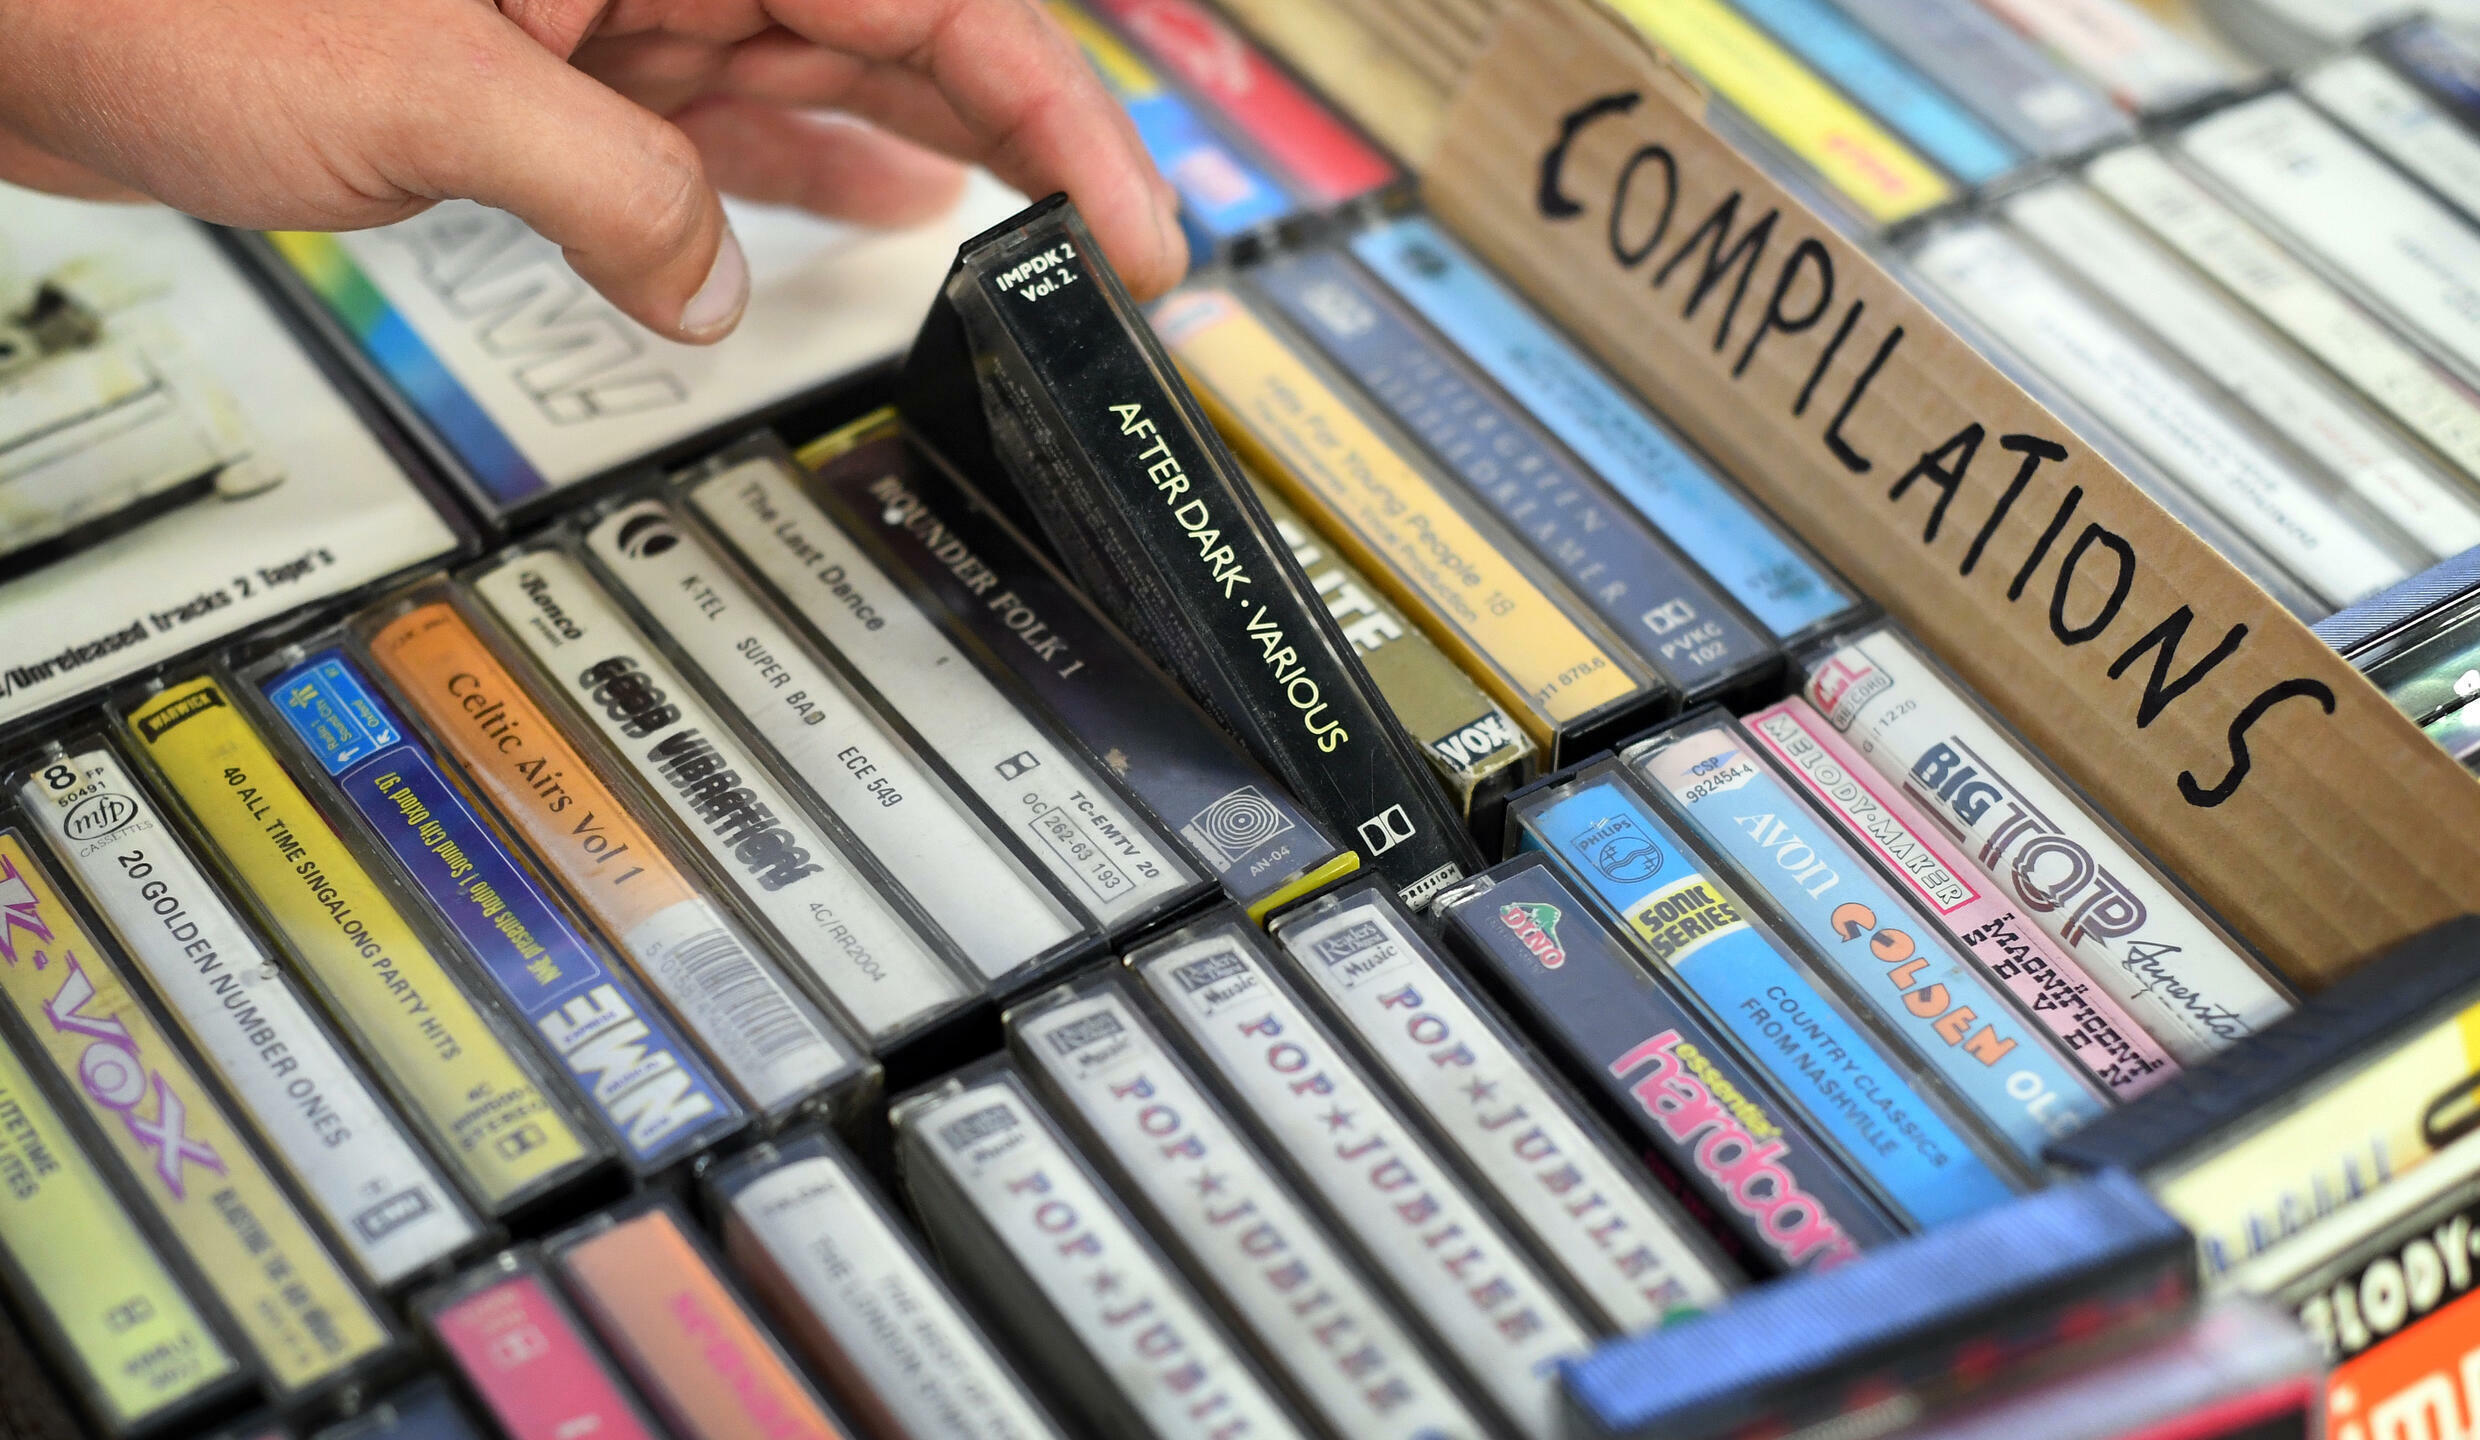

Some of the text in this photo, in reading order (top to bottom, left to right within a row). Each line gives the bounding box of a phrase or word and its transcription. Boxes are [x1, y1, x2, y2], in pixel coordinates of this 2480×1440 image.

[995, 242, 1077, 292] IMPDK 2
[1020, 268, 1078, 303] Vol. 2.
[1537, 91, 2336, 810] COMPILATIONS
[775, 521, 825, 568] Last
[818, 563, 887, 633] Dance
[1108, 403, 1349, 754] AFTER DARK VARIOUS
[1406, 513, 1482, 588] People
[1486, 589, 1517, 618] 18
[150, 590, 233, 634] tracks
[234, 576, 256, 599] 2
[519, 570, 584, 642] Ronco
[987, 591, 1069, 663] FOLK
[1688, 640, 1729, 666] 102
[736, 636, 792, 690] SUPER
[785, 689, 828, 727] BAD
[837, 746, 878, 781] ECE
[867, 776, 905, 809] 549
[1437, 713, 1513, 771] VOX
[43, 763, 77, 791] 8
[58, 779, 108, 808] 50491
[447, 672, 525, 756] Celtic
[514, 756, 574, 815] Airs
[571, 811, 630, 865] Vol
[1686, 763, 1754, 805] 982454-4
[1690, 757, 1720, 778] CSP
[74, 795, 126, 832] mfp
[79, 820, 155, 859] CASSETTES
[388, 786, 431, 827] Oxford
[418, 819, 446, 847] City
[646, 727, 825, 892] VIBRATIONS
[1021, 791, 1122, 891] OC 262-63 193
[1068, 789, 1161, 880] TC-EMTV 20
[1578, 818, 1633, 853] PHILIPS
[431, 840, 473, 878] Sound
[1248, 844, 1291, 878] AN-04
[1908, 741, 2148, 950] BIG TOP
[223, 766, 464, 1062] 40 ALL TIME SINGALONG PARTY HITS
[469, 880, 502, 919] Radio
[494, 910, 545, 961] presents
[1637, 882, 1717, 935] SONIC
[1650, 902, 1742, 959] SERIES
[809, 900, 887, 983] 4C/RR2004
[1342, 944, 1398, 987] Music
[1501, 905, 1565, 969] DINO
[117, 849, 353, 1150] 20 GOLDEN NUMBER ONES
[1830, 902, 2019, 1068] GOLDEN
[1982, 917, 2154, 1076] MAGNIFICENT
[536, 982, 715, 1152] NME
[1740, 996, 1899, 1159] FROM NASHVILLE
[1766, 984, 1948, 1169] COUNTRY CLASSICS
[1238, 1011, 1335, 1096] POP
[1335, 1135, 1546, 1340] JUBILEE
[1377, 982, 1689, 1306] POP JUBILEE
[1006, 1169, 1104, 1258] POP
[1108, 1073, 1415, 1415] POP JUBILEE
